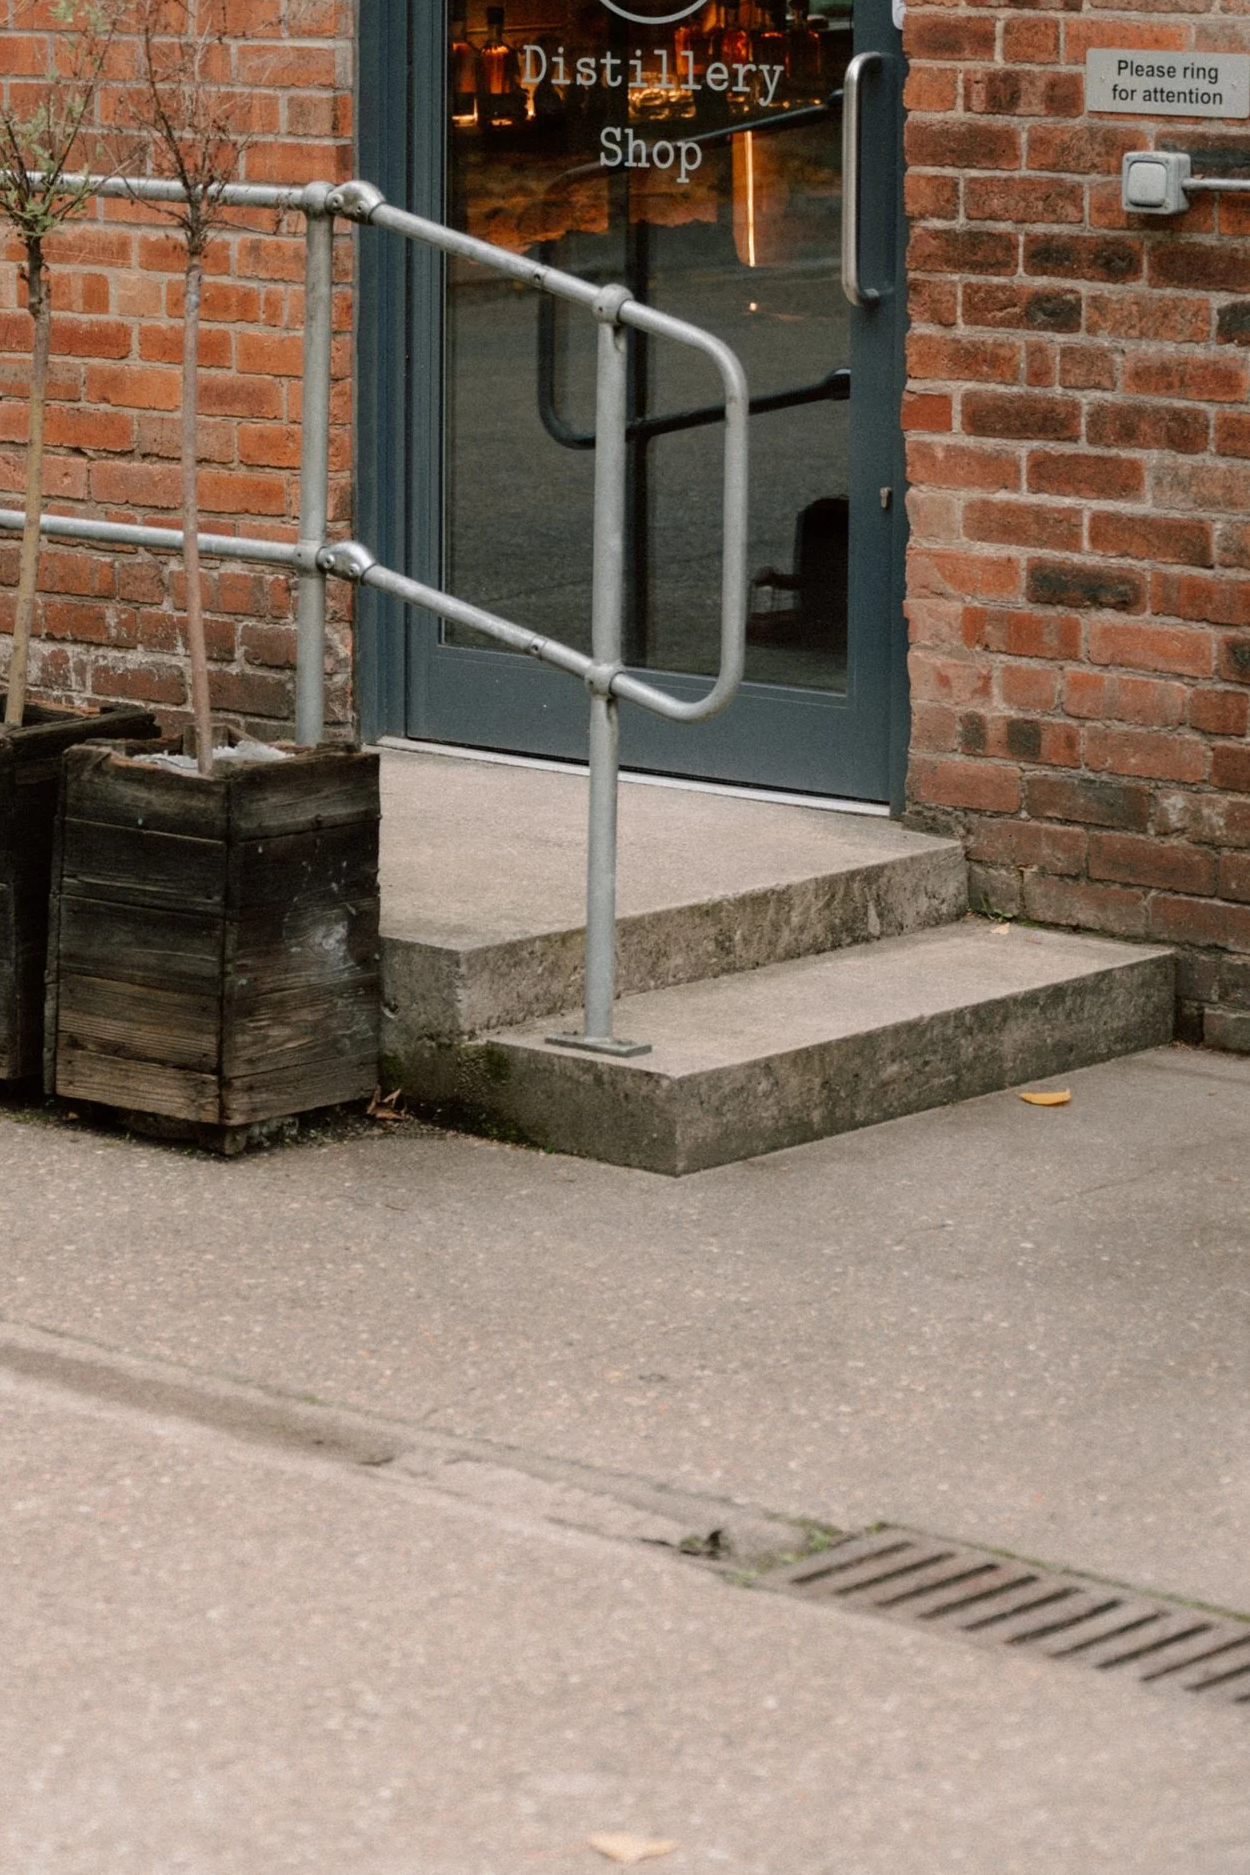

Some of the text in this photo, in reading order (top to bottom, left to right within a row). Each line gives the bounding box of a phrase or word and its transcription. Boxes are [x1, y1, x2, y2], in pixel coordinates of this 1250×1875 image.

[523, 44, 785, 107] Distillery
[1117, 59, 1219, 84] Please ring
[1112, 84, 1223, 105] for attention
[599, 126, 702, 183] Shop
